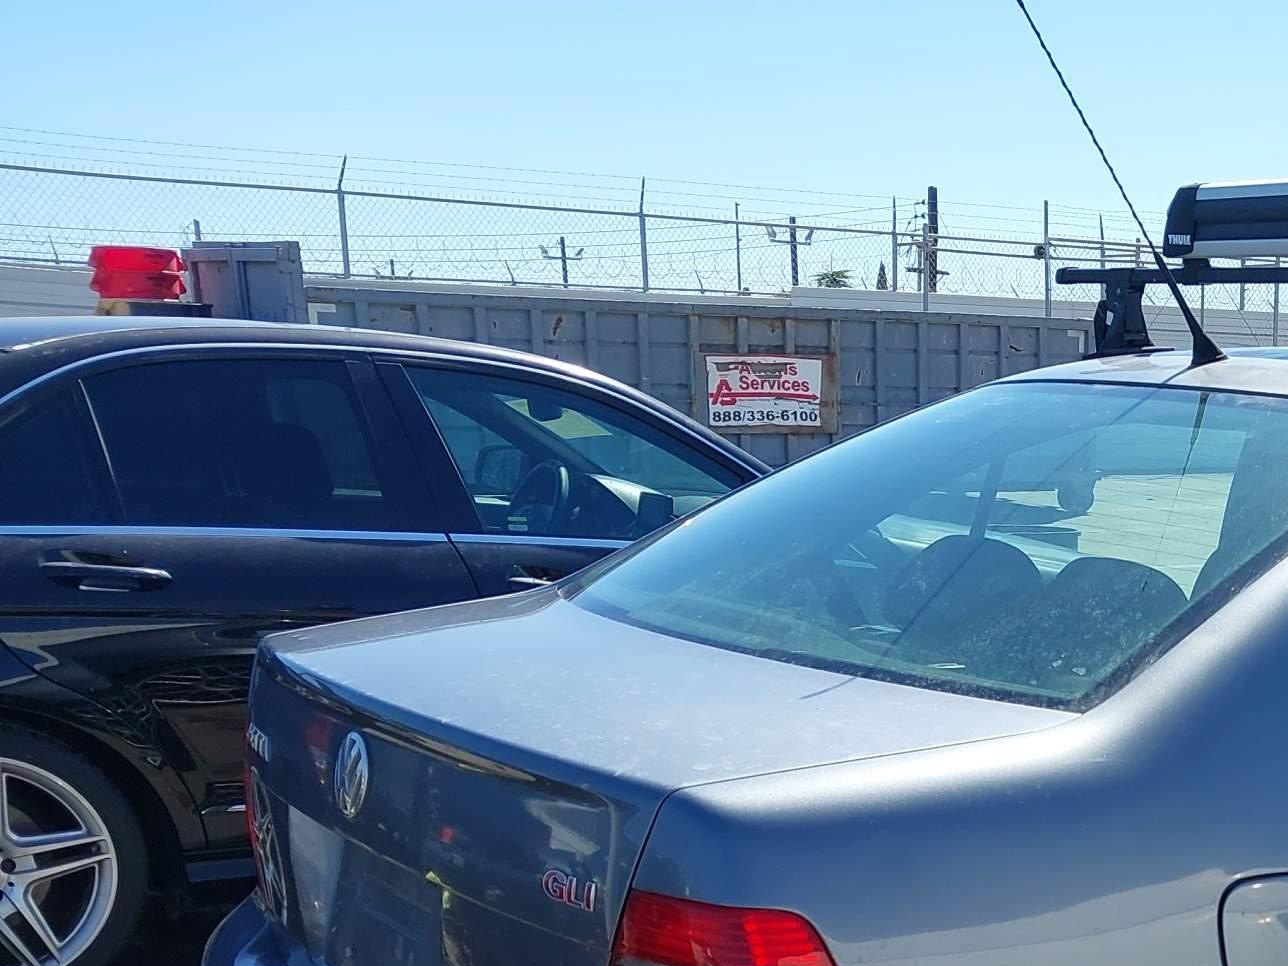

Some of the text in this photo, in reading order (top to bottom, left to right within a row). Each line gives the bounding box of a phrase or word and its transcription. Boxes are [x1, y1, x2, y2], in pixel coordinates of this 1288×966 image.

[1167, 234, 1191, 246] THULE
[739, 375, 810, 392] Services
[712, 410, 818, 423] 888/336-6100
[543, 870, 596, 912] GLI
